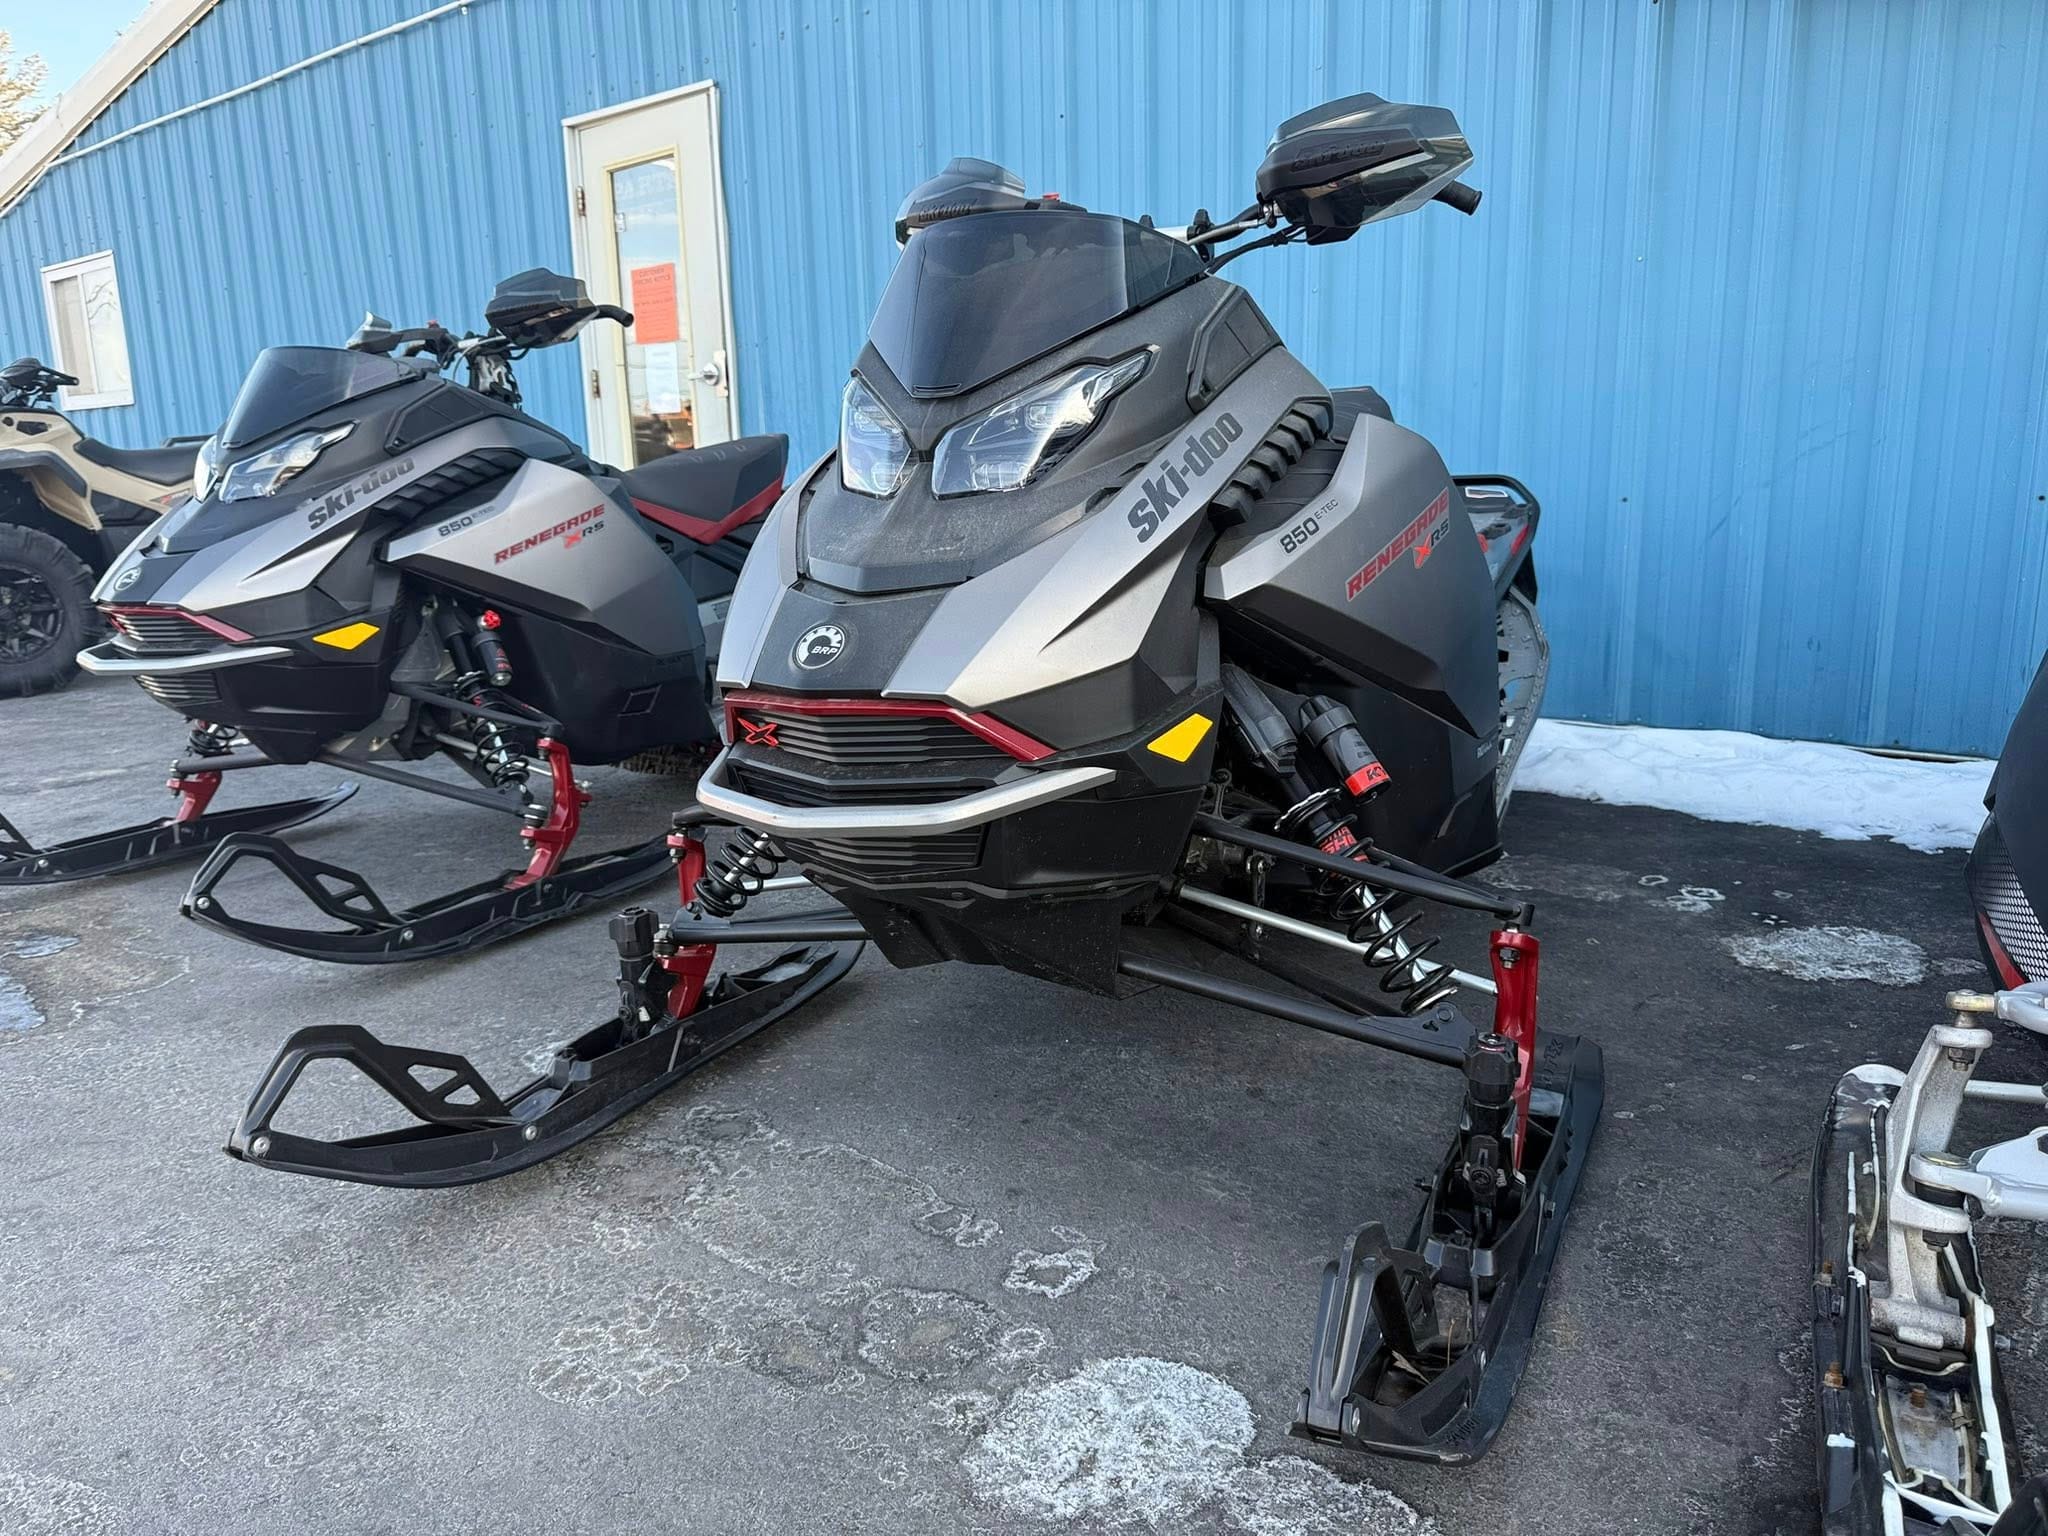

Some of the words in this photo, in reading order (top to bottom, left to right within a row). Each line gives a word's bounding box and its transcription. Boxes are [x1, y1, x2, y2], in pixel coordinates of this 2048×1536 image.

[438, 516, 473, 538] 850
[493, 503, 605, 565] RENEGADE
[1279, 517, 1321, 554] 850
[1313, 498, 1339, 520] E-TEC
[1346, 488, 1449, 601] RENEGADE
[811, 645, 838, 655] BRP
